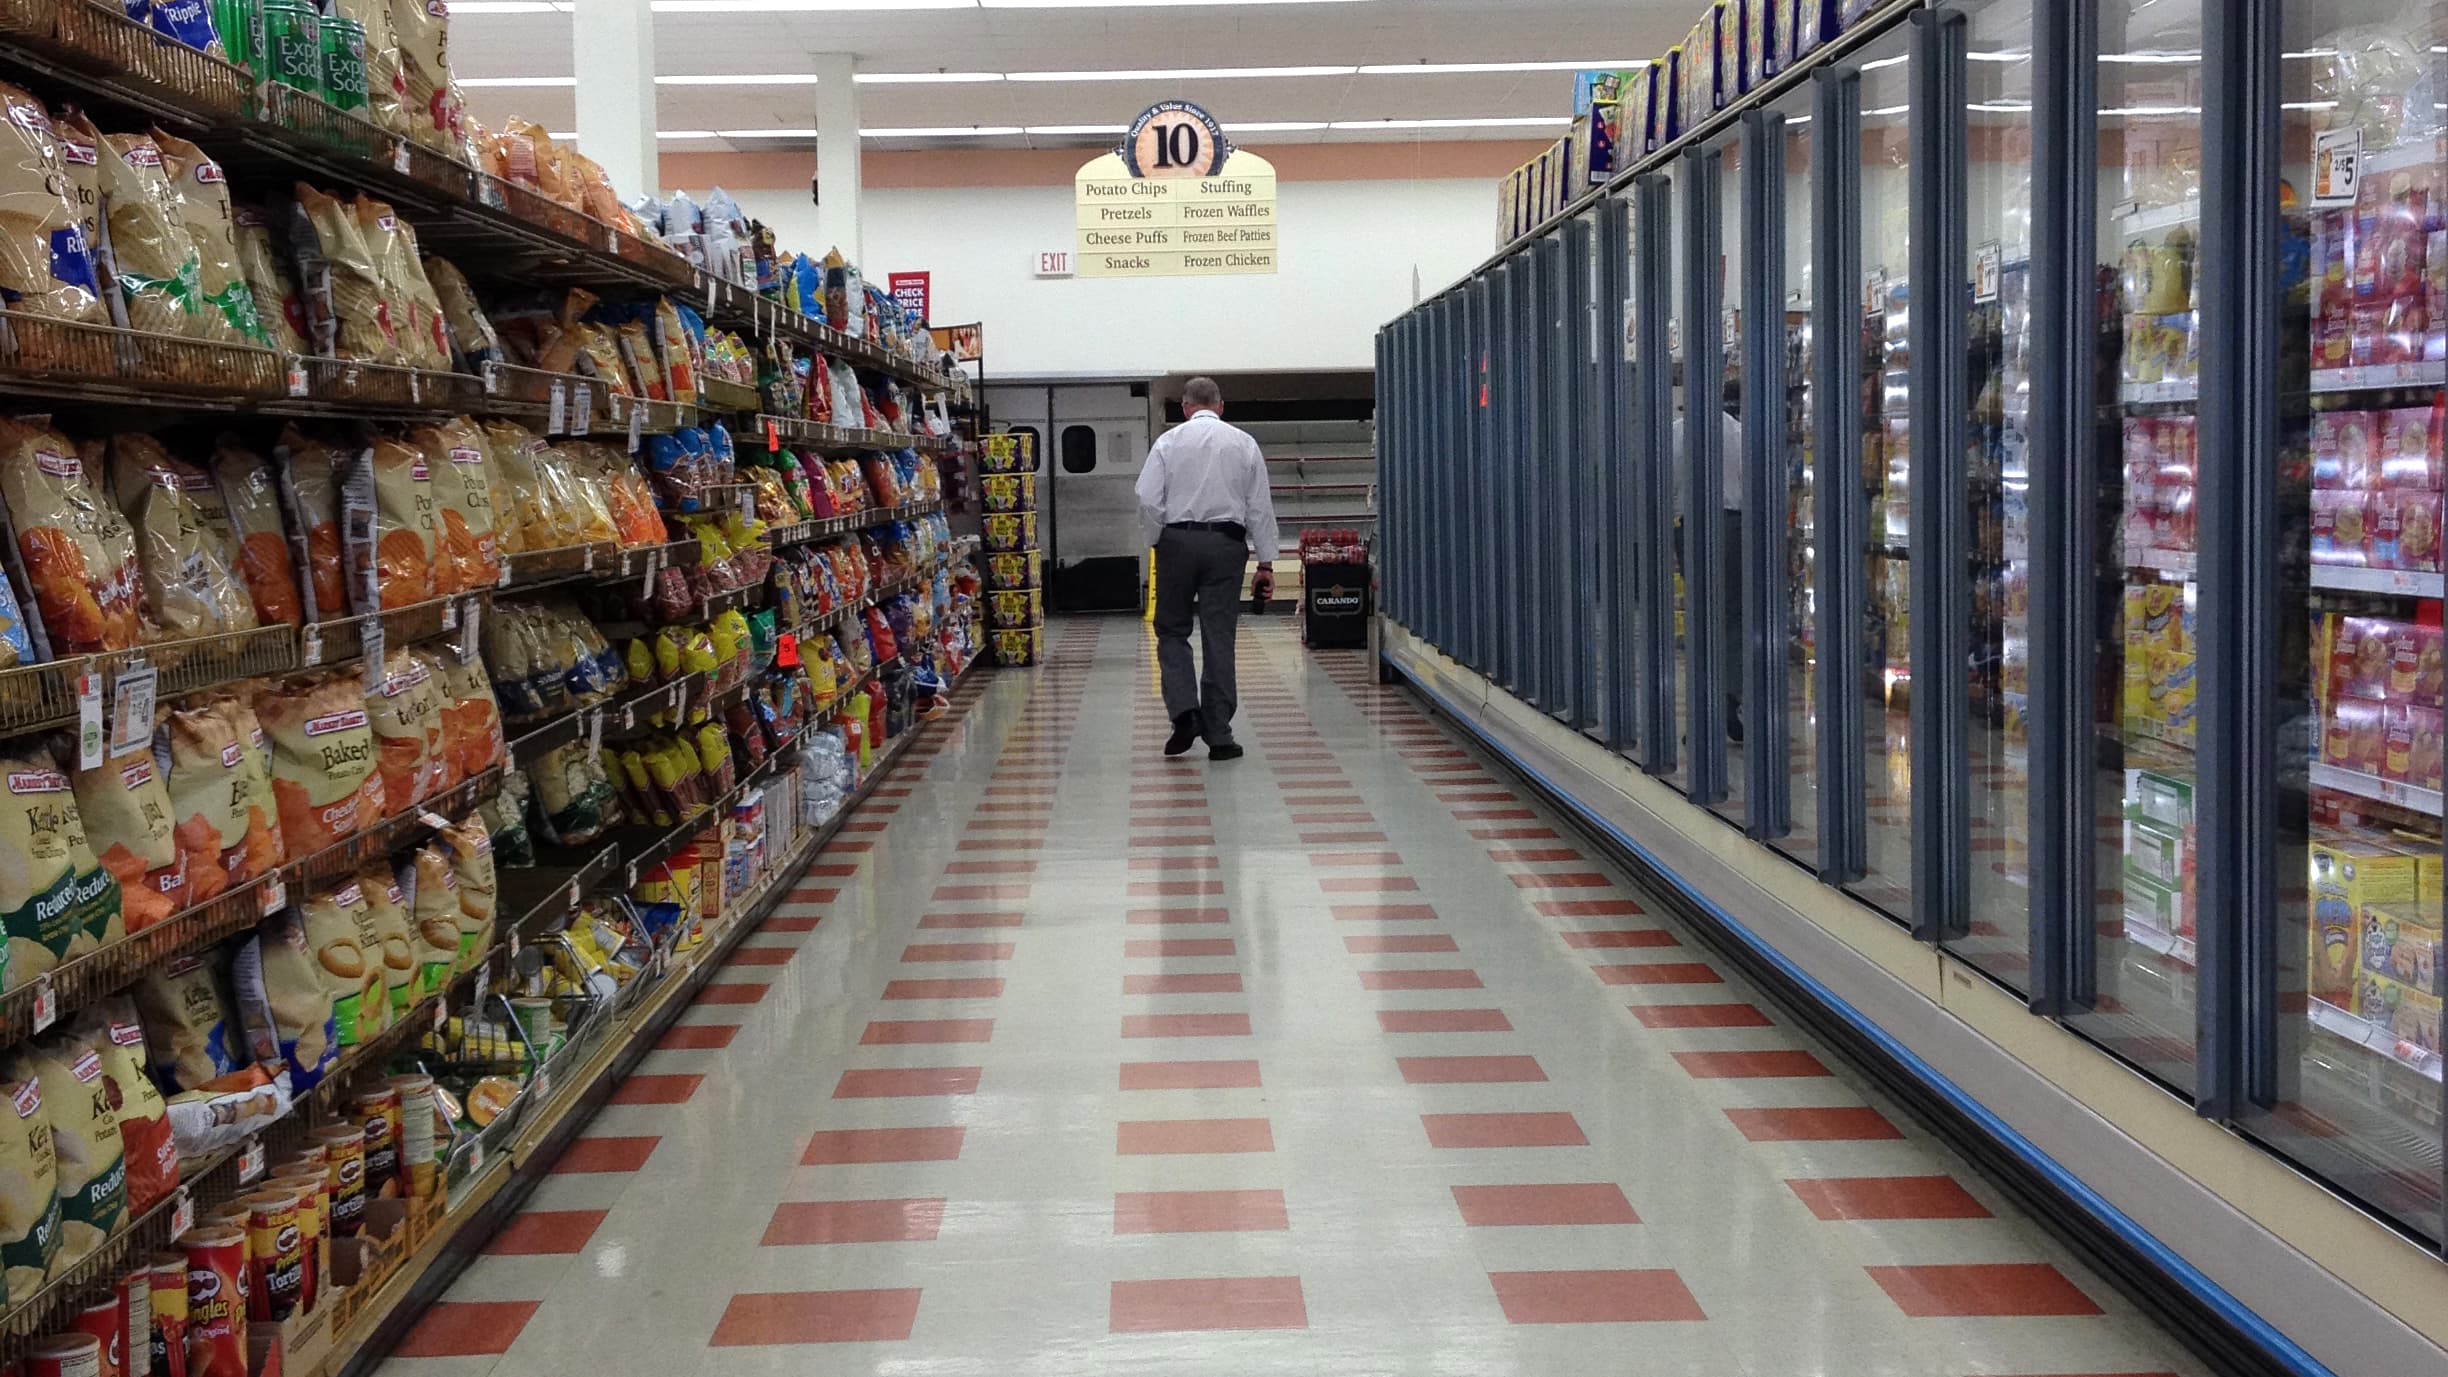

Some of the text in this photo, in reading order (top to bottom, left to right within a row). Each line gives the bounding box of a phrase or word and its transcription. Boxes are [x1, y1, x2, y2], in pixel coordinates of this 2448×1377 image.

[1160, 102, 1183, 110] Value
[1184, 104, 1206, 120] Since
[1204, 117, 1219, 136] 1917
[1152, 123, 1198, 168] 10
[1086, 182, 1168, 198] Potato Chips
[1200, 180, 1252, 195] Stuffing
[1101, 206, 1152, 220] Pretzels
[1184, 204, 1270, 218] Frozen Waffles
[1086, 230, 1168, 245] Cheese Puffs
[1183, 228, 1271, 243] Frozen Beef Patties
[1041, 252, 1068, 272] EXIT
[1105, 255, 1150, 269] Snacks
[1184, 252, 1270, 267] Frozen Chicken
[895, 288, 924, 297] CHECK
[1316, 597, 1359, 605] CARANDO
[322, 738, 369, 771] Baked
